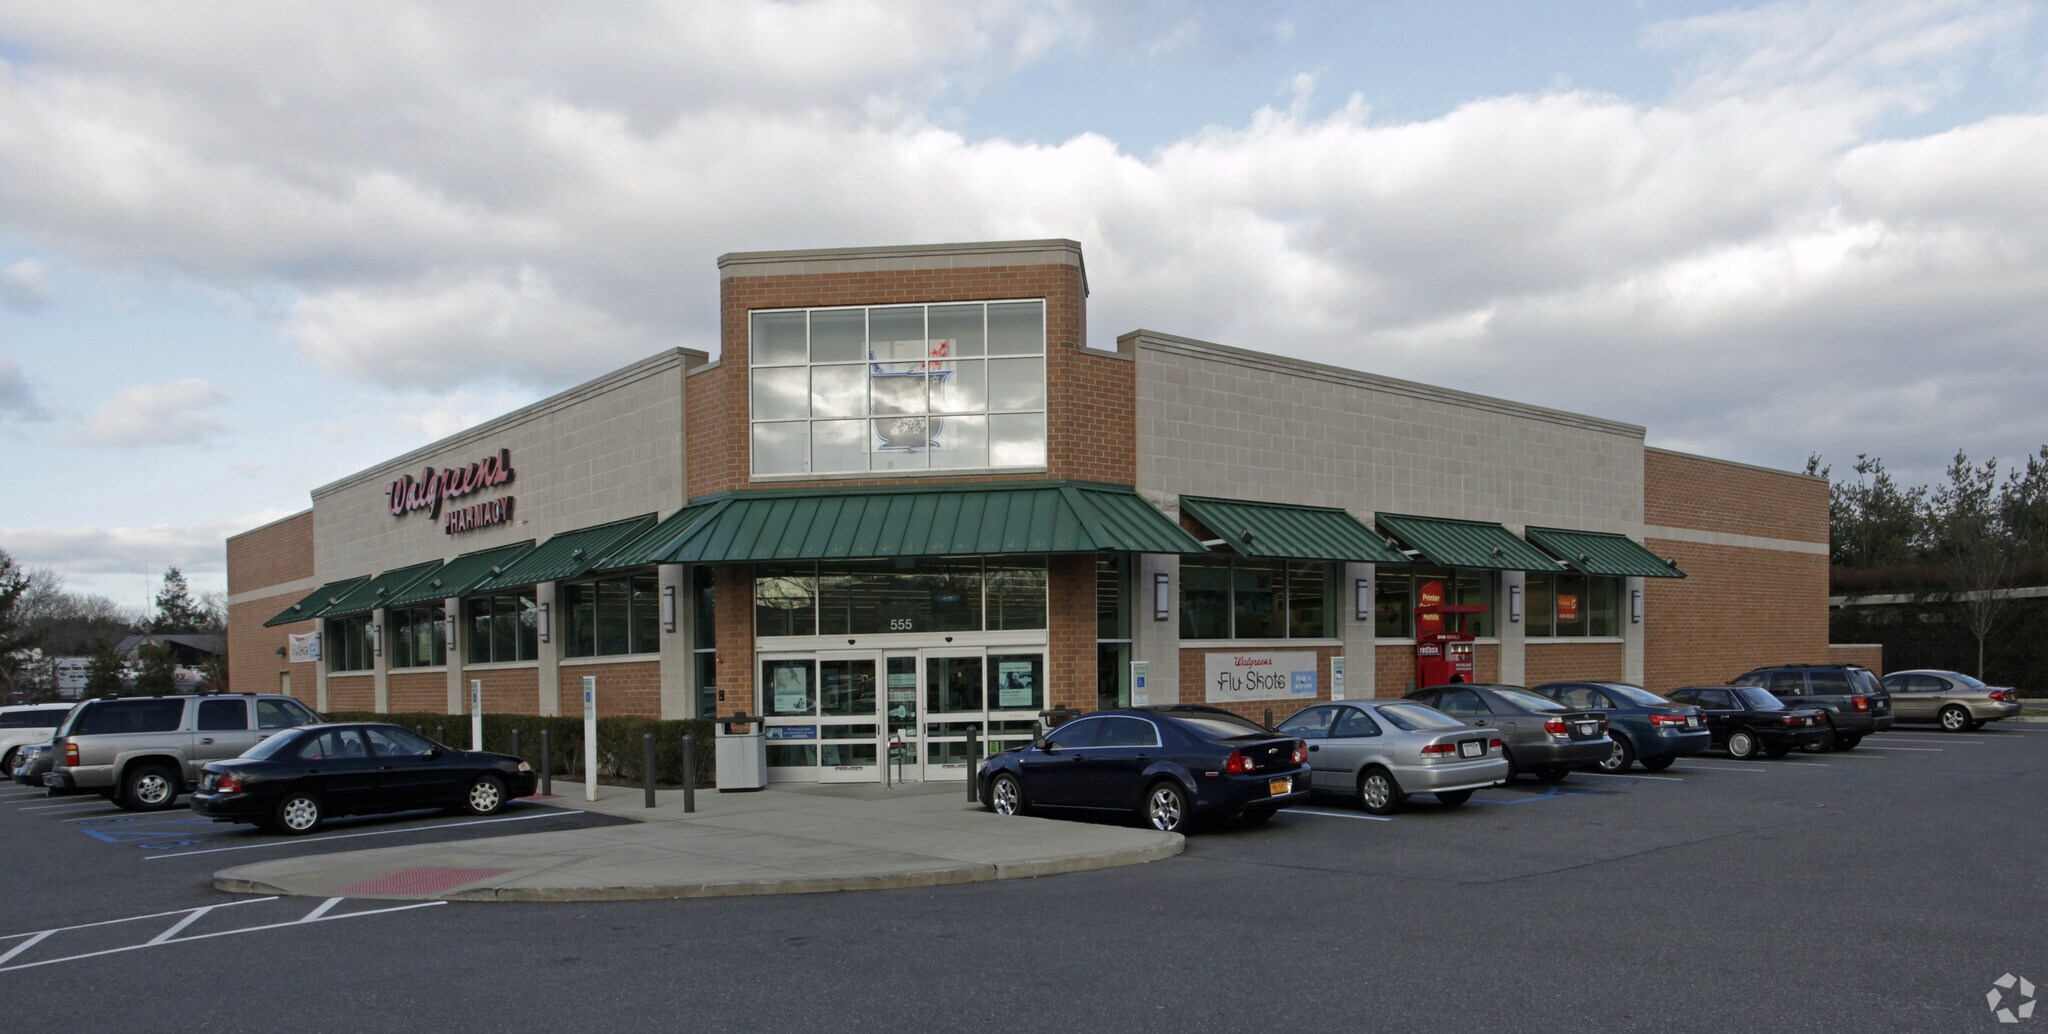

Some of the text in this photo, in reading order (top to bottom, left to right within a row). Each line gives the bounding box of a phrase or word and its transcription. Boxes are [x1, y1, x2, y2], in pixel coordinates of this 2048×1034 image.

[385, 448, 514, 519] Walgreens
[444, 496, 514, 534] PHARMACY
[1422, 593, 1440, 602] Printer
[890, 618, 913, 630] 555
[1234, 656, 1273, 669] Walgreens
[1217, 670, 1286, 691] Flu Shots
